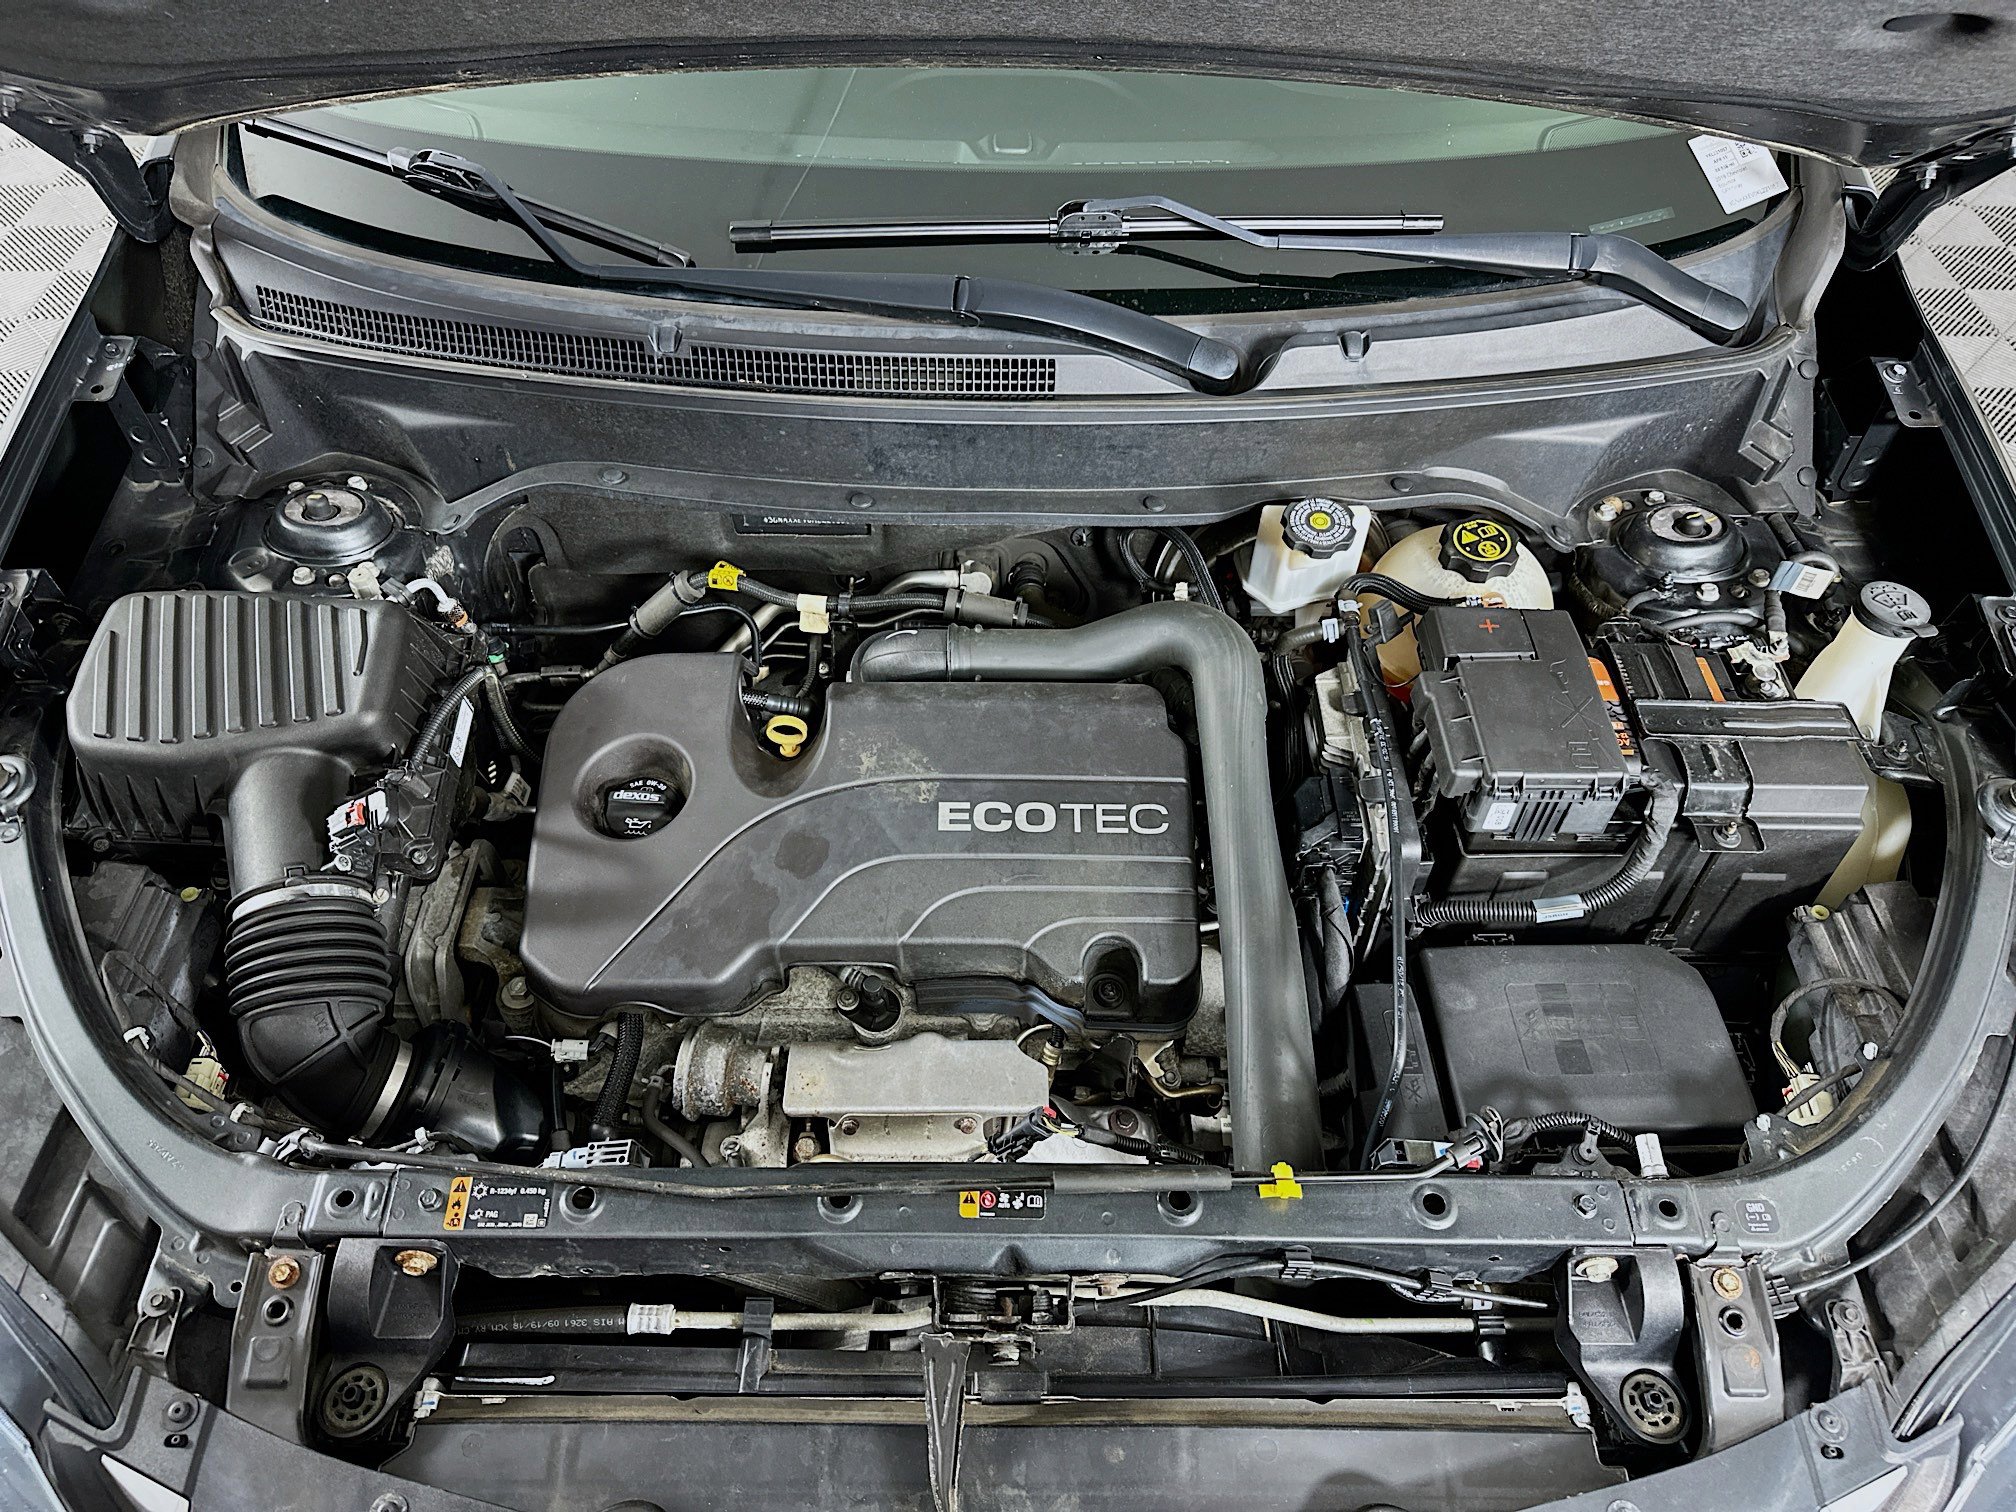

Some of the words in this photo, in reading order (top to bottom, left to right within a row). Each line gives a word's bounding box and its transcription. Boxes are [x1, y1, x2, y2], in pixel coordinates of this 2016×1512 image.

[629, 780, 644, 788] SAE
[613, 790, 661, 802] dexos
[937, 801, 1170, 835] ECOTEC
[489, 1186, 518, 1197] R-1234yf
[519, 1186, 538, 1196] 0.450
[538, 1186, 547, 1197] kg
[1745, 1202, 1766, 1213] GND
[485, 1210, 499, 1219] PAG
[513, 1319, 560, 1330] 09/19/18
[564, 1318, 588, 1327] 3261
[593, 1318, 614, 1326] AIS
